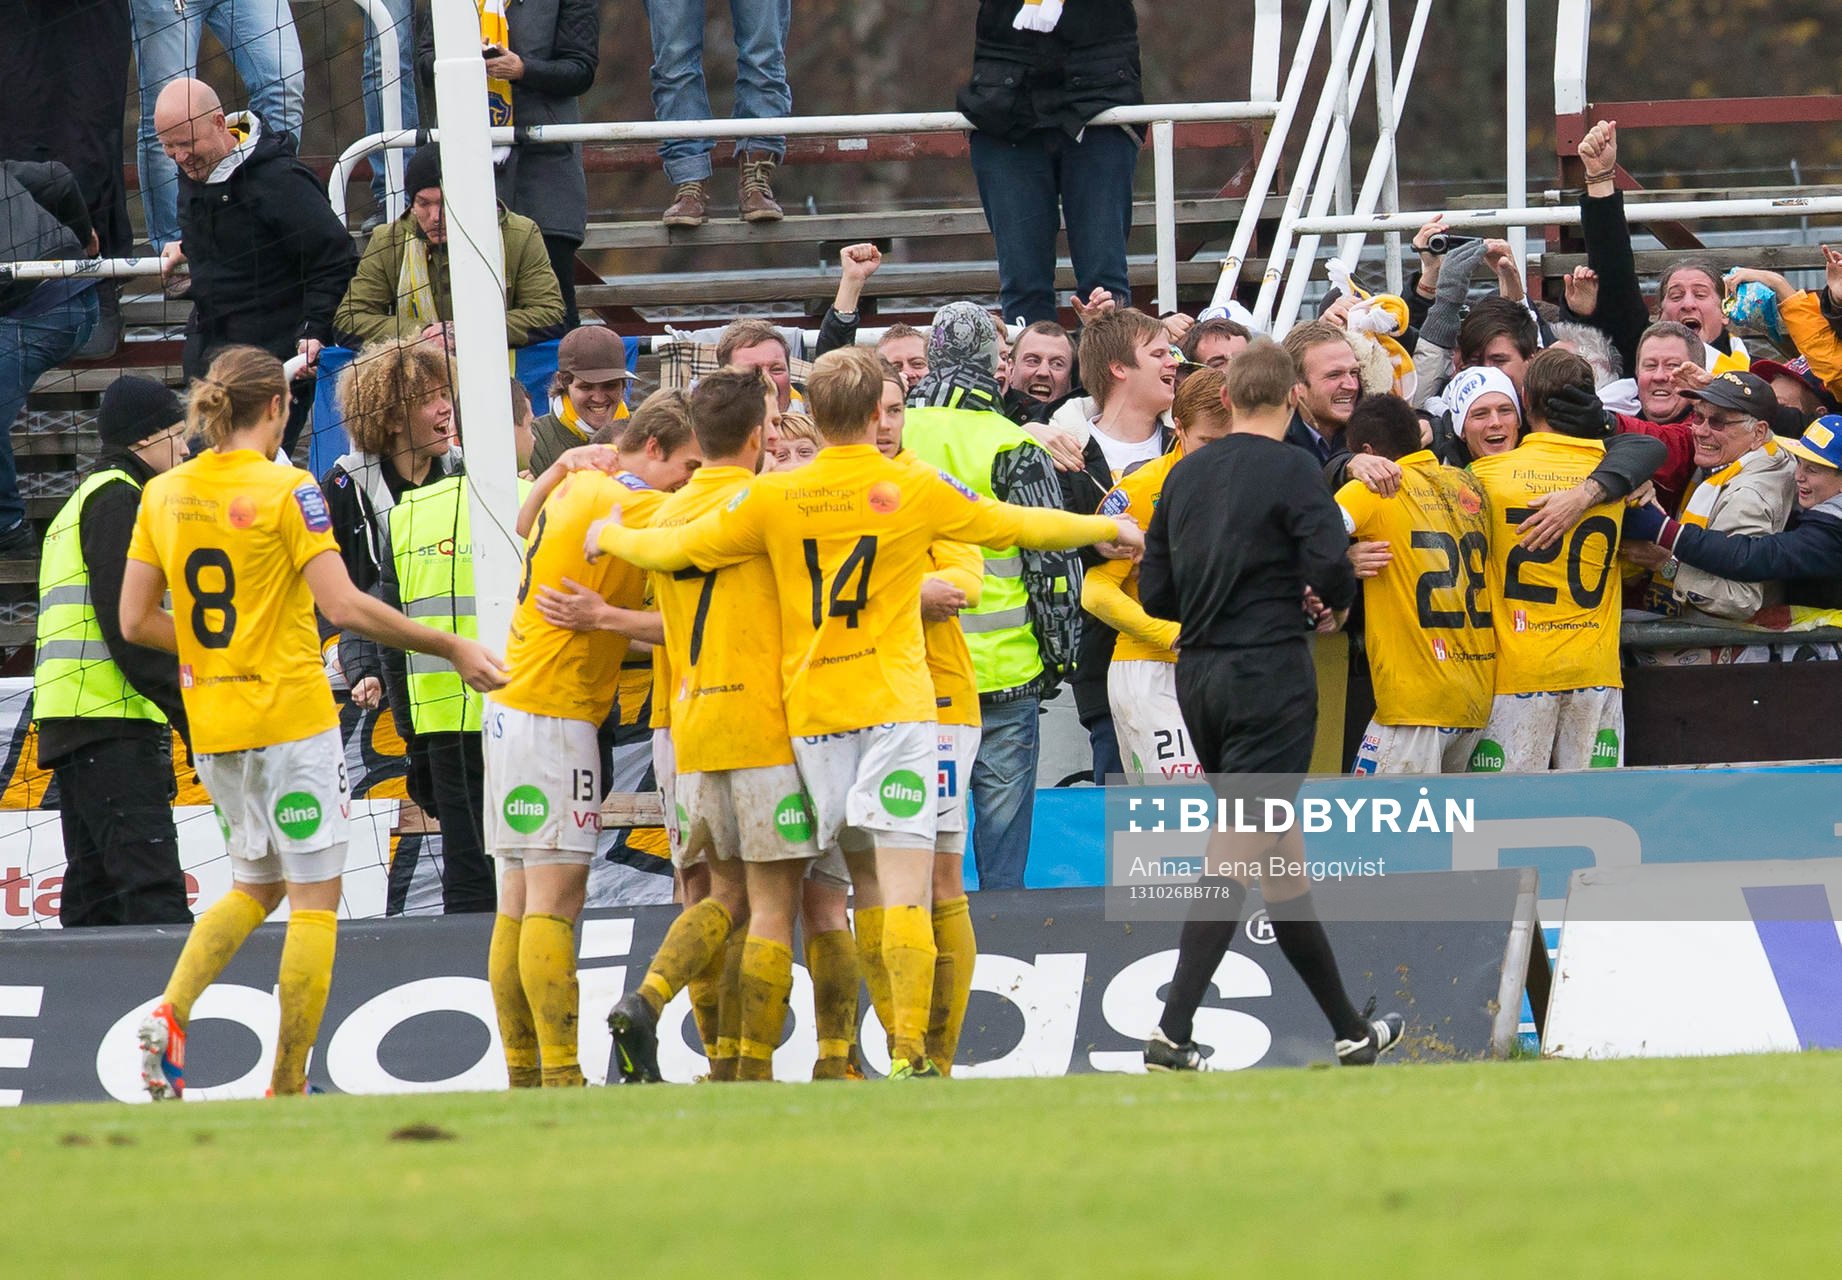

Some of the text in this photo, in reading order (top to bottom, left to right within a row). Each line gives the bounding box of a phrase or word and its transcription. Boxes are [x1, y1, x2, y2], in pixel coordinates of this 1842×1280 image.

[1512, 469, 1586, 484] Falkenbergs
[784, 486, 855, 501] Falkenbergs
[797, 500, 855, 517] Sparbank
[1503, 506, 1618, 609] 20
[802, 535, 878, 631] 14
[1410, 530, 1495, 630] 28
[184, 547, 237, 649] 8
[673, 565, 717, 667] 7
[1153, 728, 1186, 761] 21
[1472, 753, 1503, 768] dina
[573, 768, 594, 802] 13
[883, 784, 923, 803] dina
[278, 805, 319, 824] dina
[507, 800, 545, 817] dina
